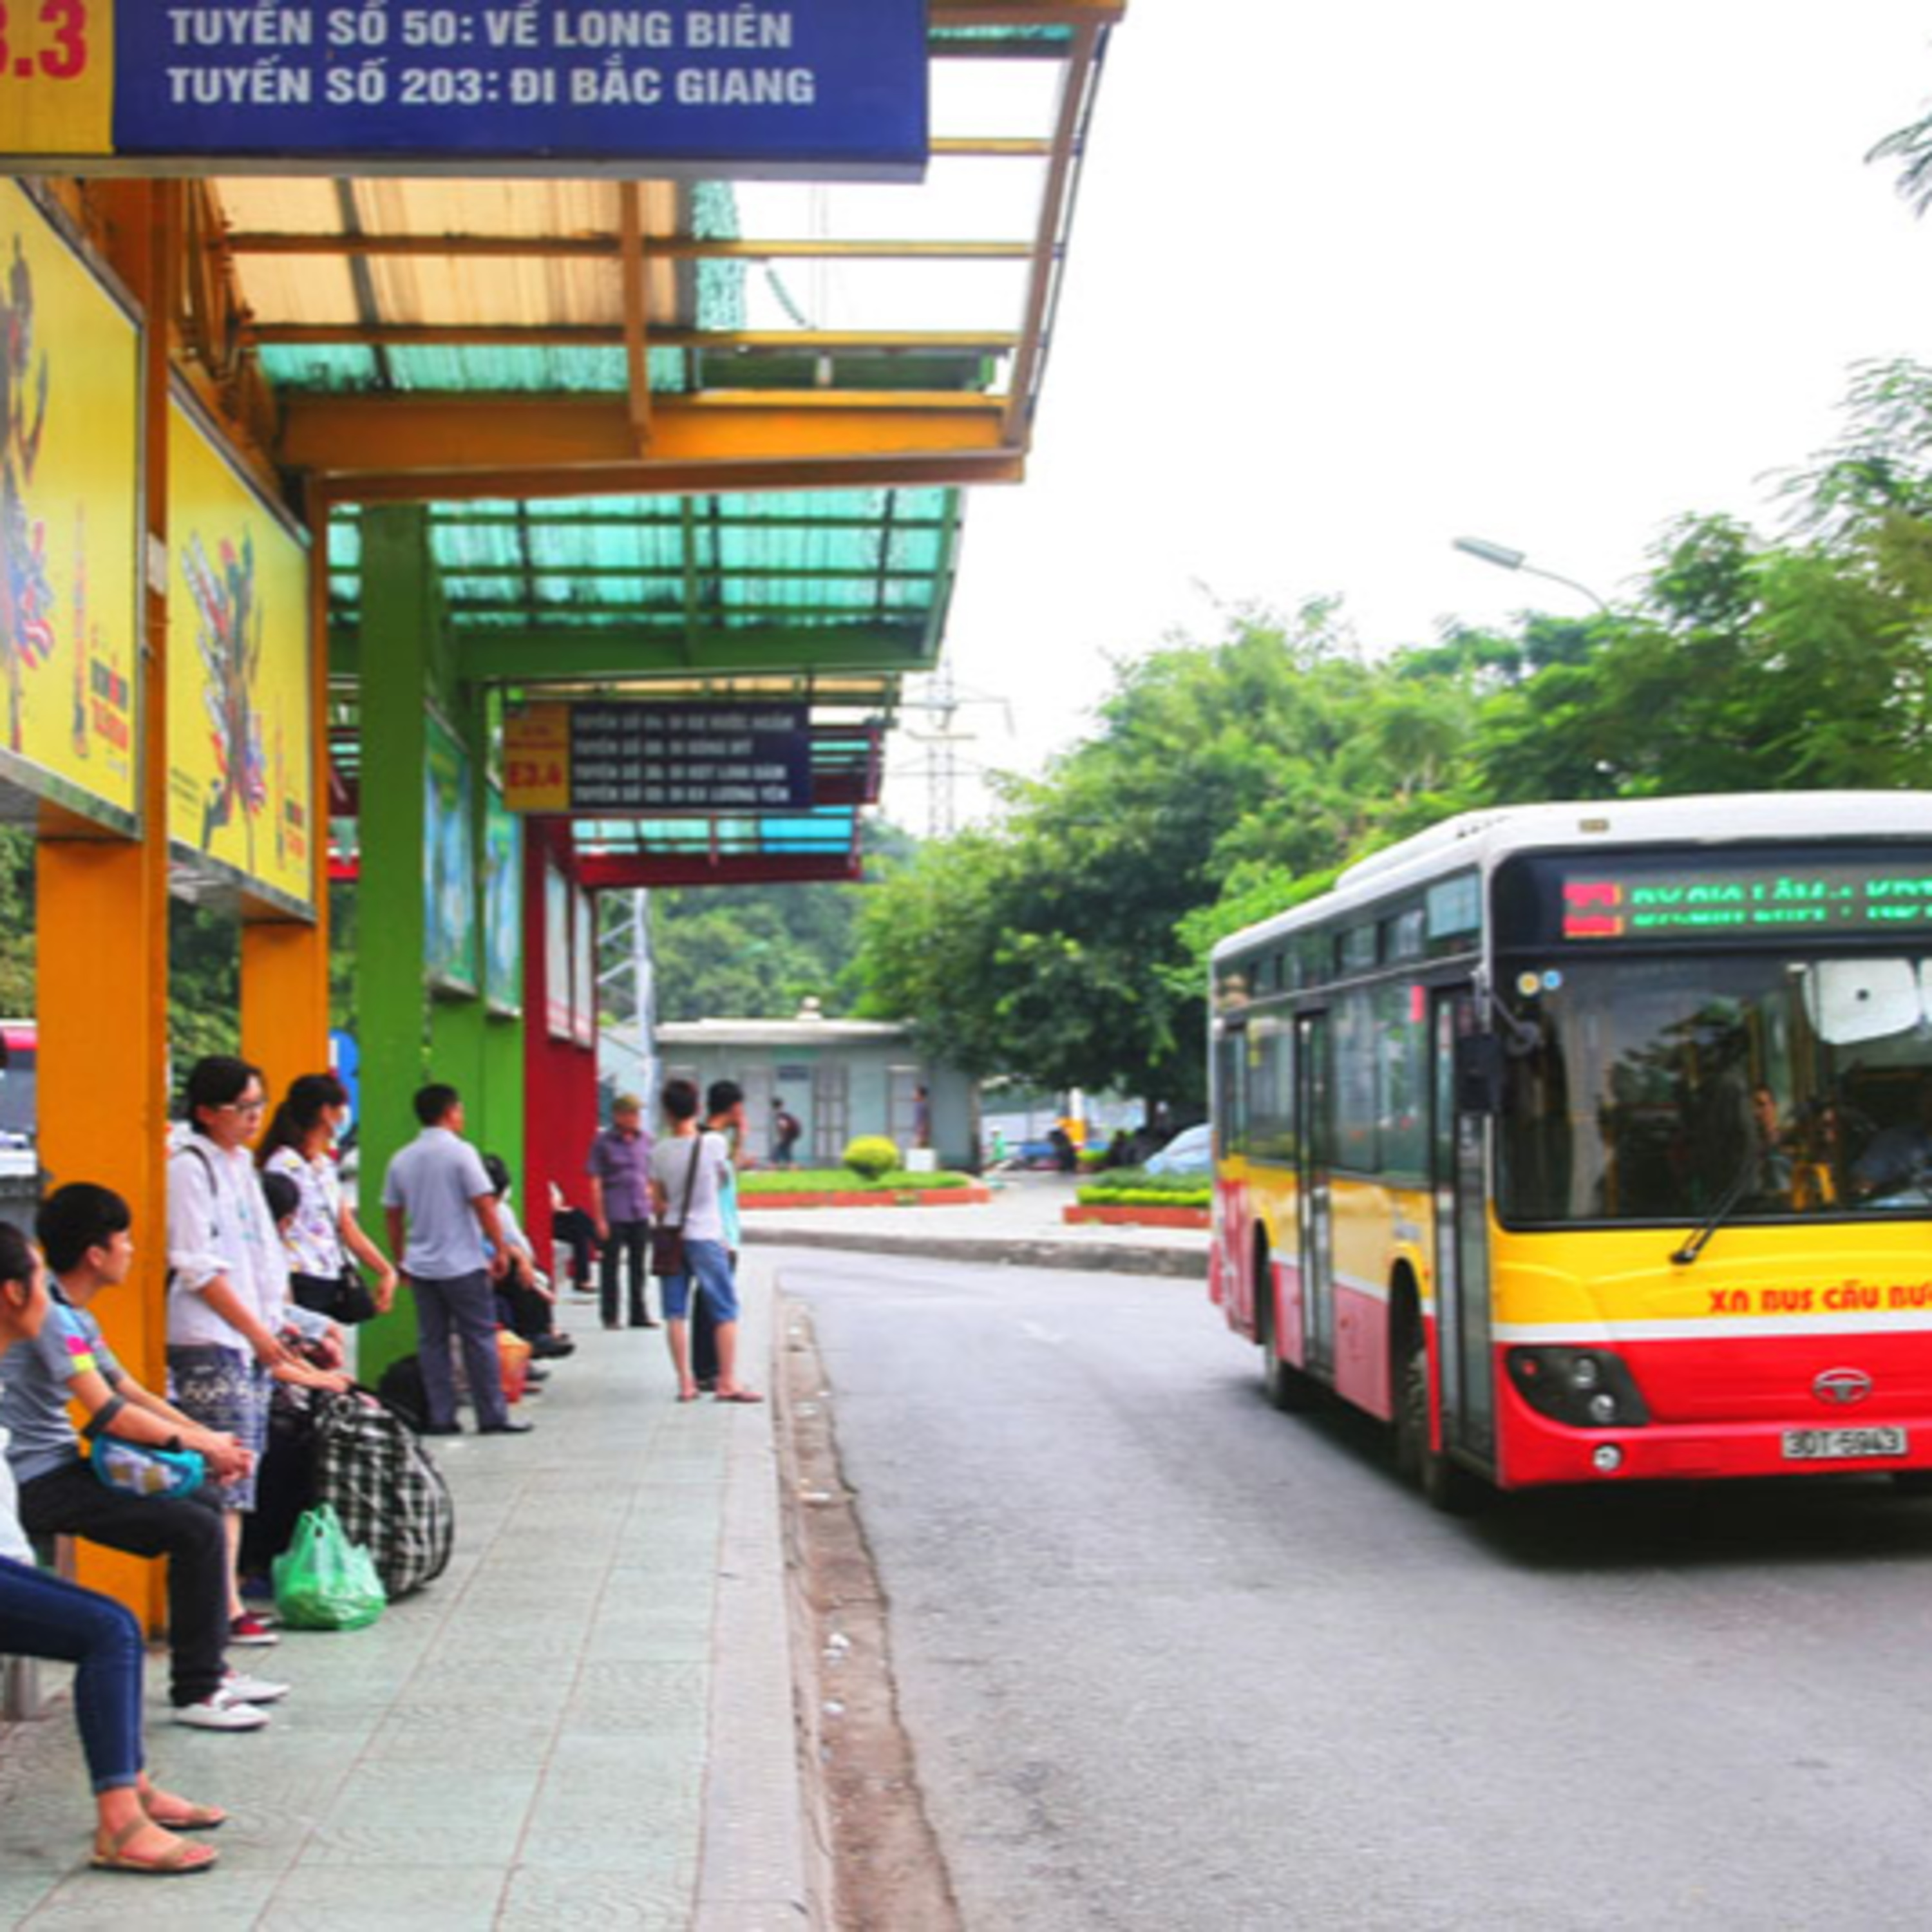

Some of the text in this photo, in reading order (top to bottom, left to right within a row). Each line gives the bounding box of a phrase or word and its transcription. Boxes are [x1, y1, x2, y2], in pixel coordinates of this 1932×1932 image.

[0, 0, 88, 79] .3
[167, 0, 312, 45] TUYẾN
[327, 0, 387, 46] SỐ
[402, 9, 472, 46] 50:
[554, 10, 672, 48] LONG
[687, 3, 791, 48] BIÊN
[167, 53, 816, 104] TUYẾN SỐ 203: ĐI BẮC GIANG
